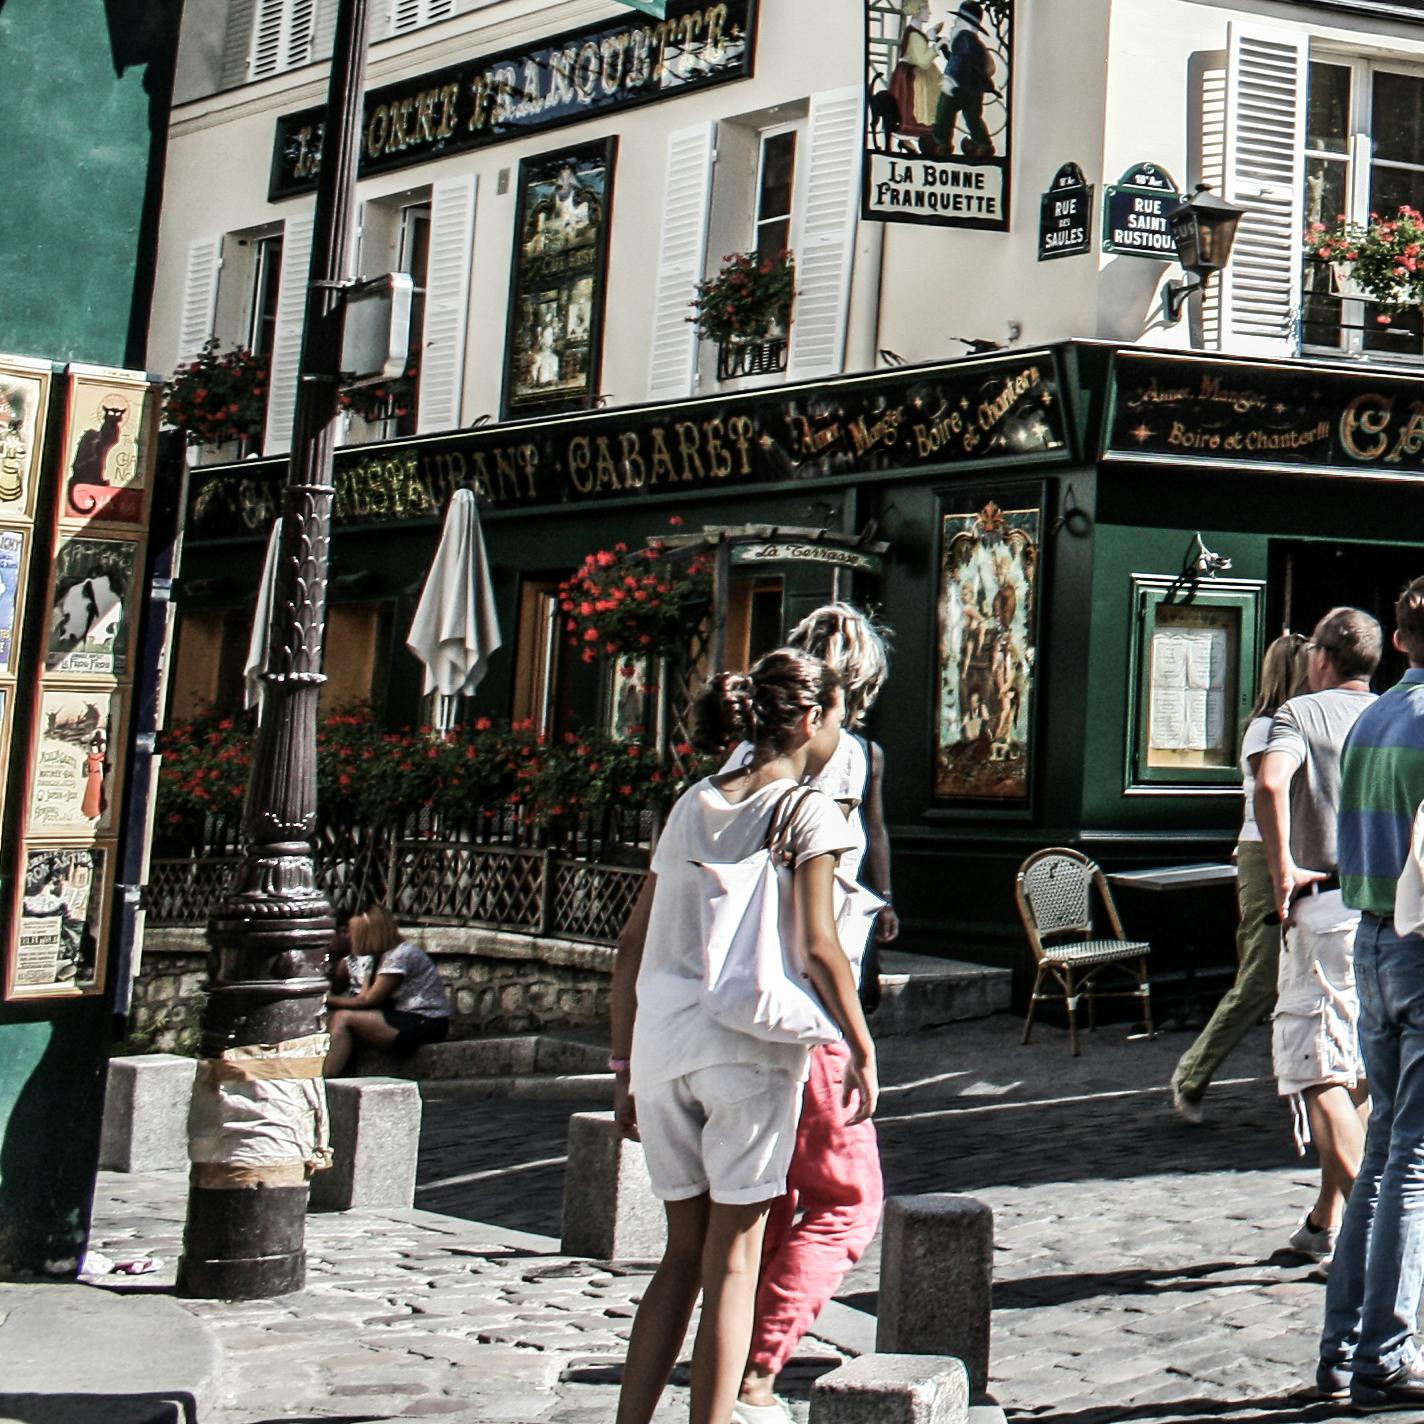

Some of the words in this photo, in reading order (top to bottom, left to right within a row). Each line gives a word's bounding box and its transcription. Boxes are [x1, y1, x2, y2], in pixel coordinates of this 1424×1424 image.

[367, 80, 461, 159] ONNE
[887, 161, 912, 184] LA
[922, 164, 985, 190] BONNE
[873, 182, 996, 214] FRANQUETTE
[1055, 198, 1077, 217] RUE
[1133, 197, 1162, 215] RUE
[1127, 214, 1168, 232] SAINT
[1045, 227, 1084, 249] SAULES
[1167, 420, 1221, 450] Boire
[567, 409, 756, 495] CABARET
[755, 542, 780, 559] La
